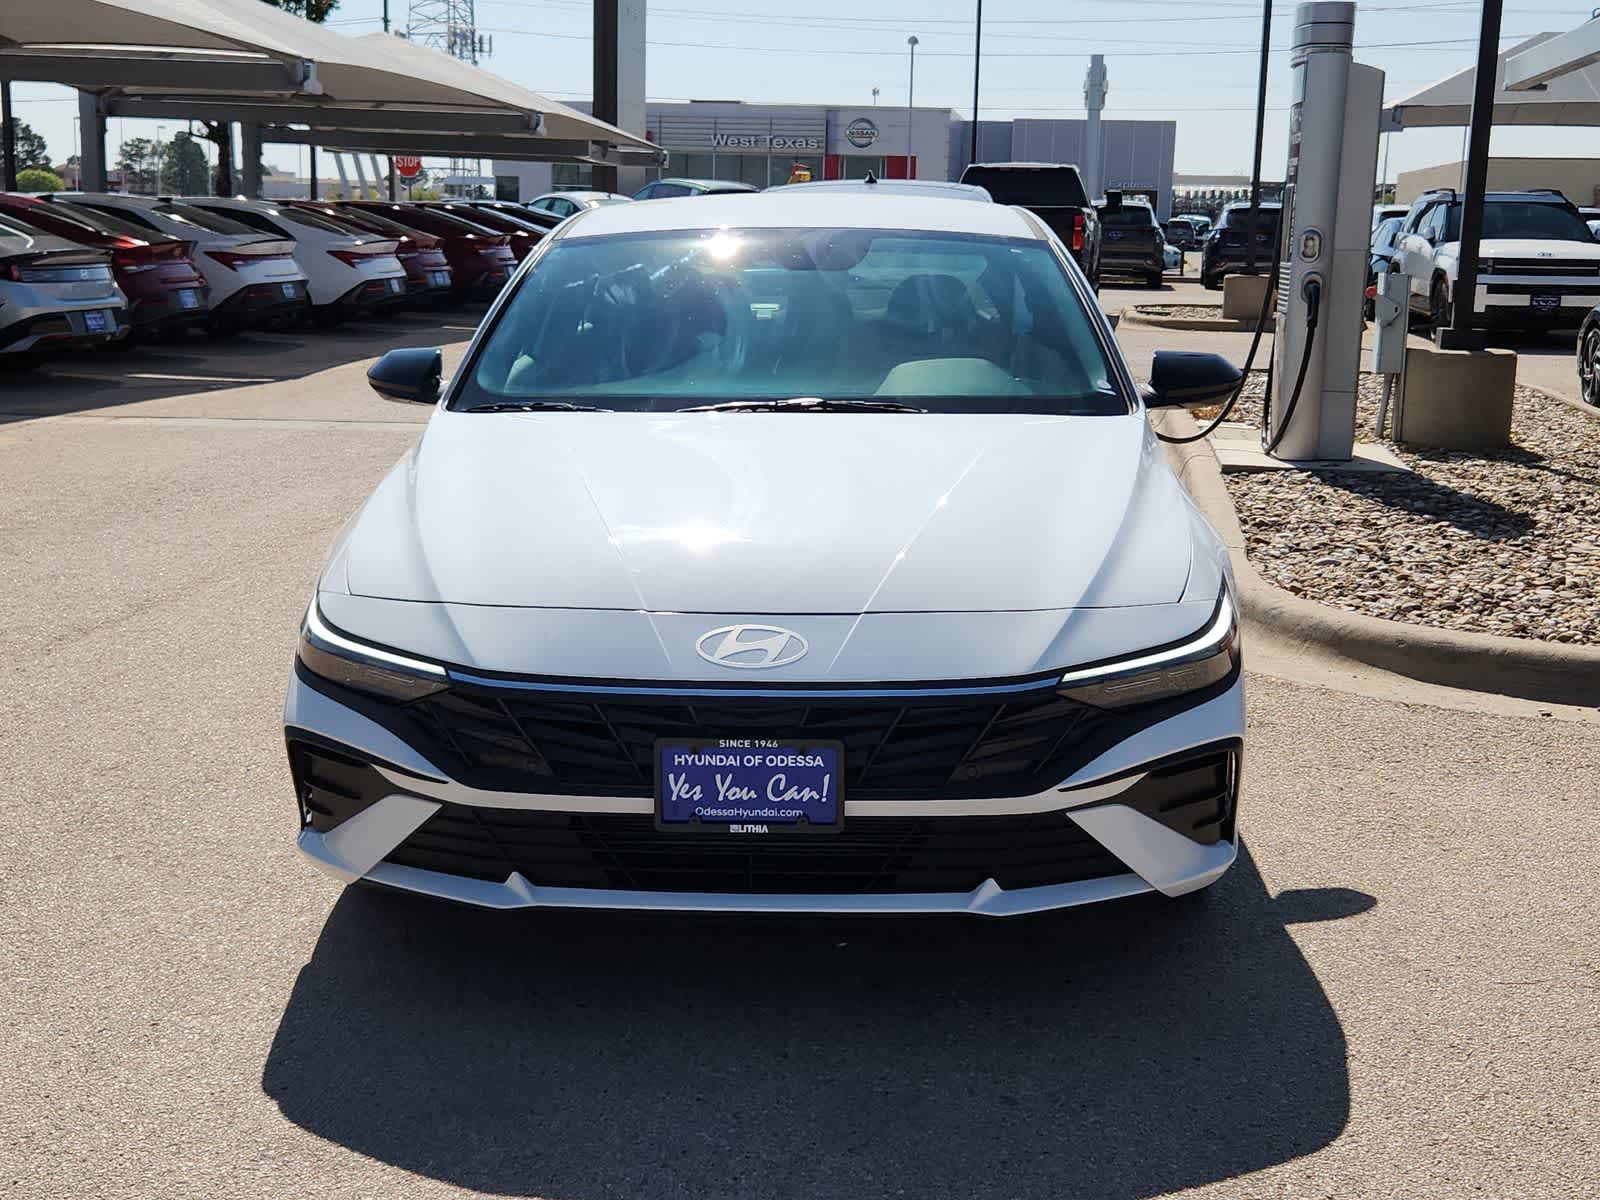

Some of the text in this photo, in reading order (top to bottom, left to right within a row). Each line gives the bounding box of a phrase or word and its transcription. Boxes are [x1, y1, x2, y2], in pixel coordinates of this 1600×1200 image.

[711, 134, 818, 149] West Texas
[397, 155, 420, 167] STOP
[719, 739, 779, 748] SINCE 1946
[674, 754, 824, 767] HYUNDAI OF ODESSA
[668, 772, 831, 802] Yes You Can!
[695, 806, 803, 818] OdessaHyundai.com
[738, 824, 769, 833] LITHIA
